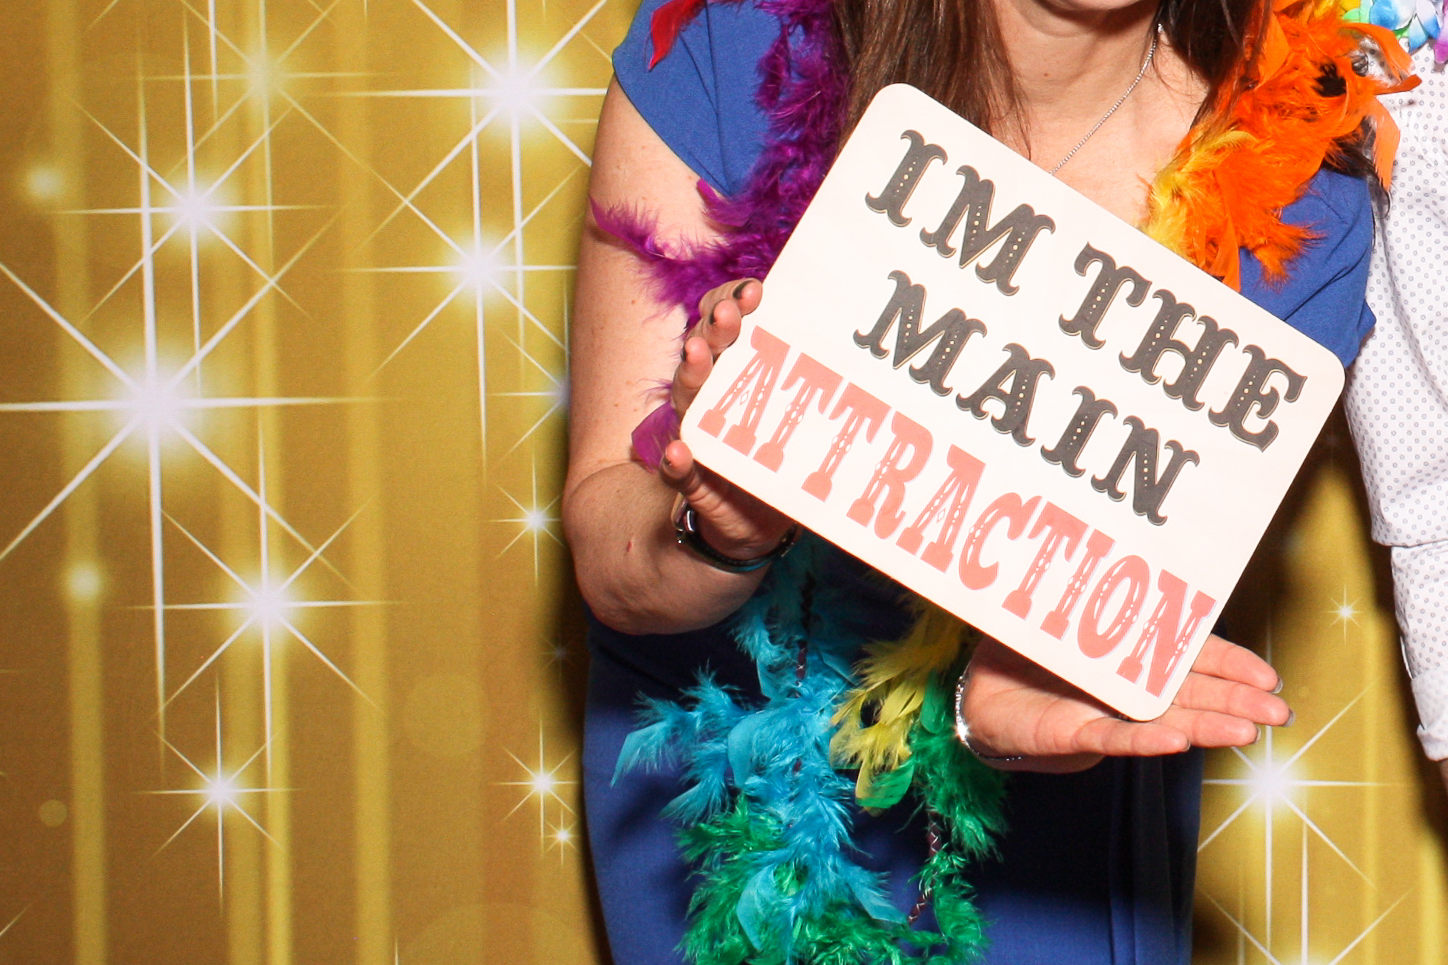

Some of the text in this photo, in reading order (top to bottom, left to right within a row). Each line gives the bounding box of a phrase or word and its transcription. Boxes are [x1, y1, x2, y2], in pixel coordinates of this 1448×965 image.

[852, 269, 1200, 526] MAIN
[864, 129, 1307, 452] IM THE
[697, 325, 1217, 699] ATTRACTION
